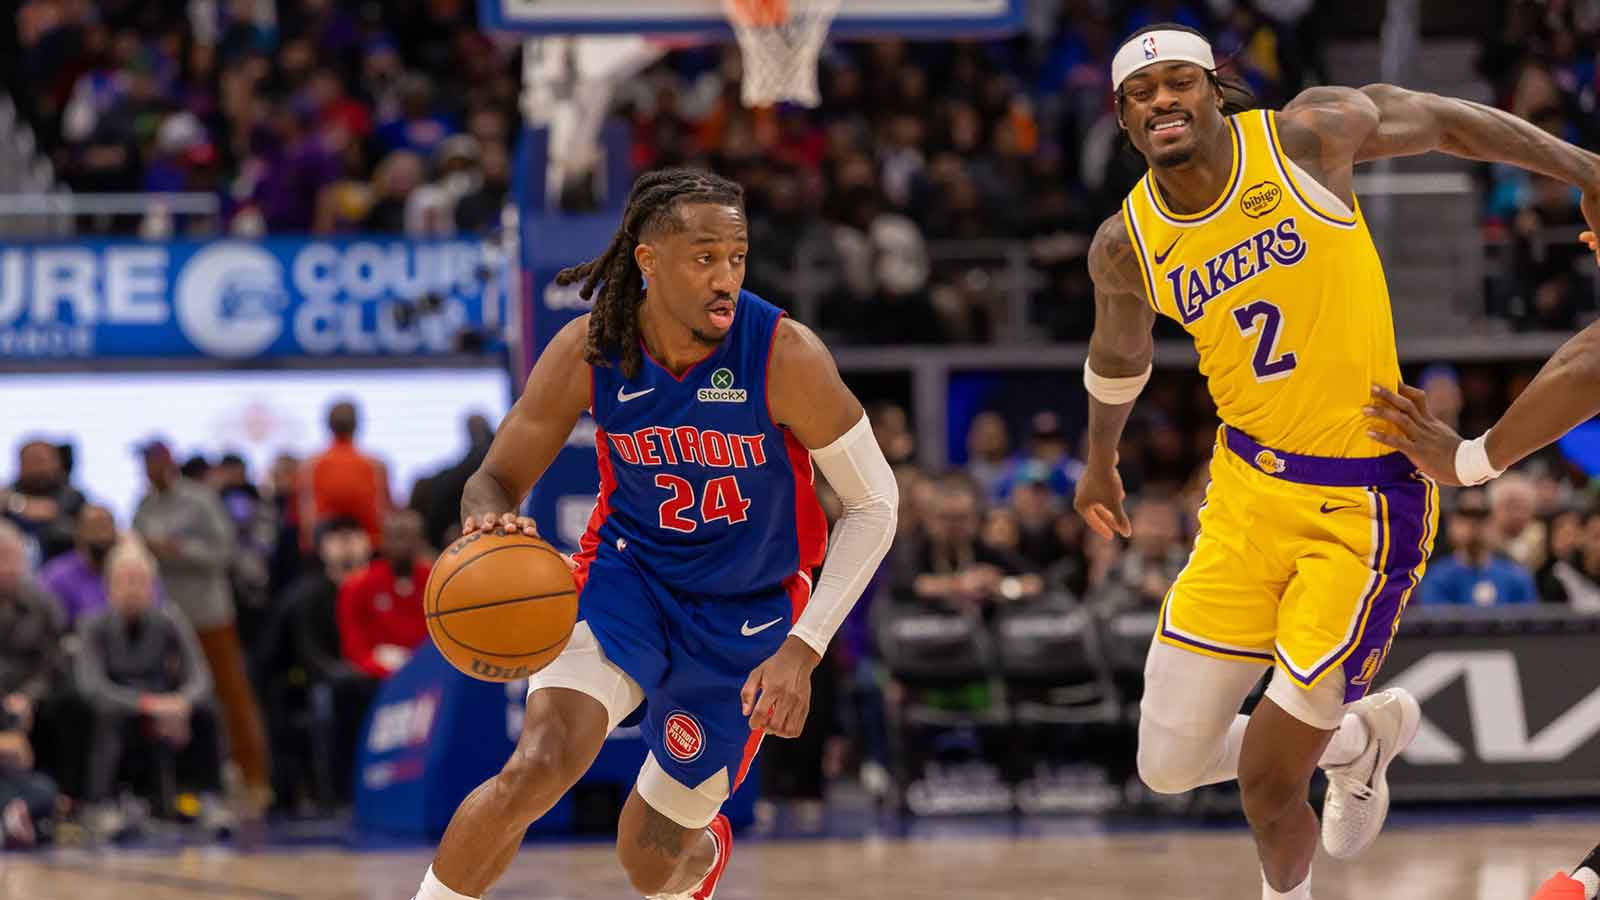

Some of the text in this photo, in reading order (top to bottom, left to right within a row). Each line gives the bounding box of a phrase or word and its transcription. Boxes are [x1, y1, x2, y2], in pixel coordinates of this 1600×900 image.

[1244, 187, 1279, 210] bibigo
[292, 242, 492, 300] COUR
[1167, 217, 1308, 326] LAKERS
[1232, 299, 1298, 384] 2
[699, 390, 745, 401] StockX
[608, 426, 767, 468] DETROIT
[655, 473, 751, 533] 24
